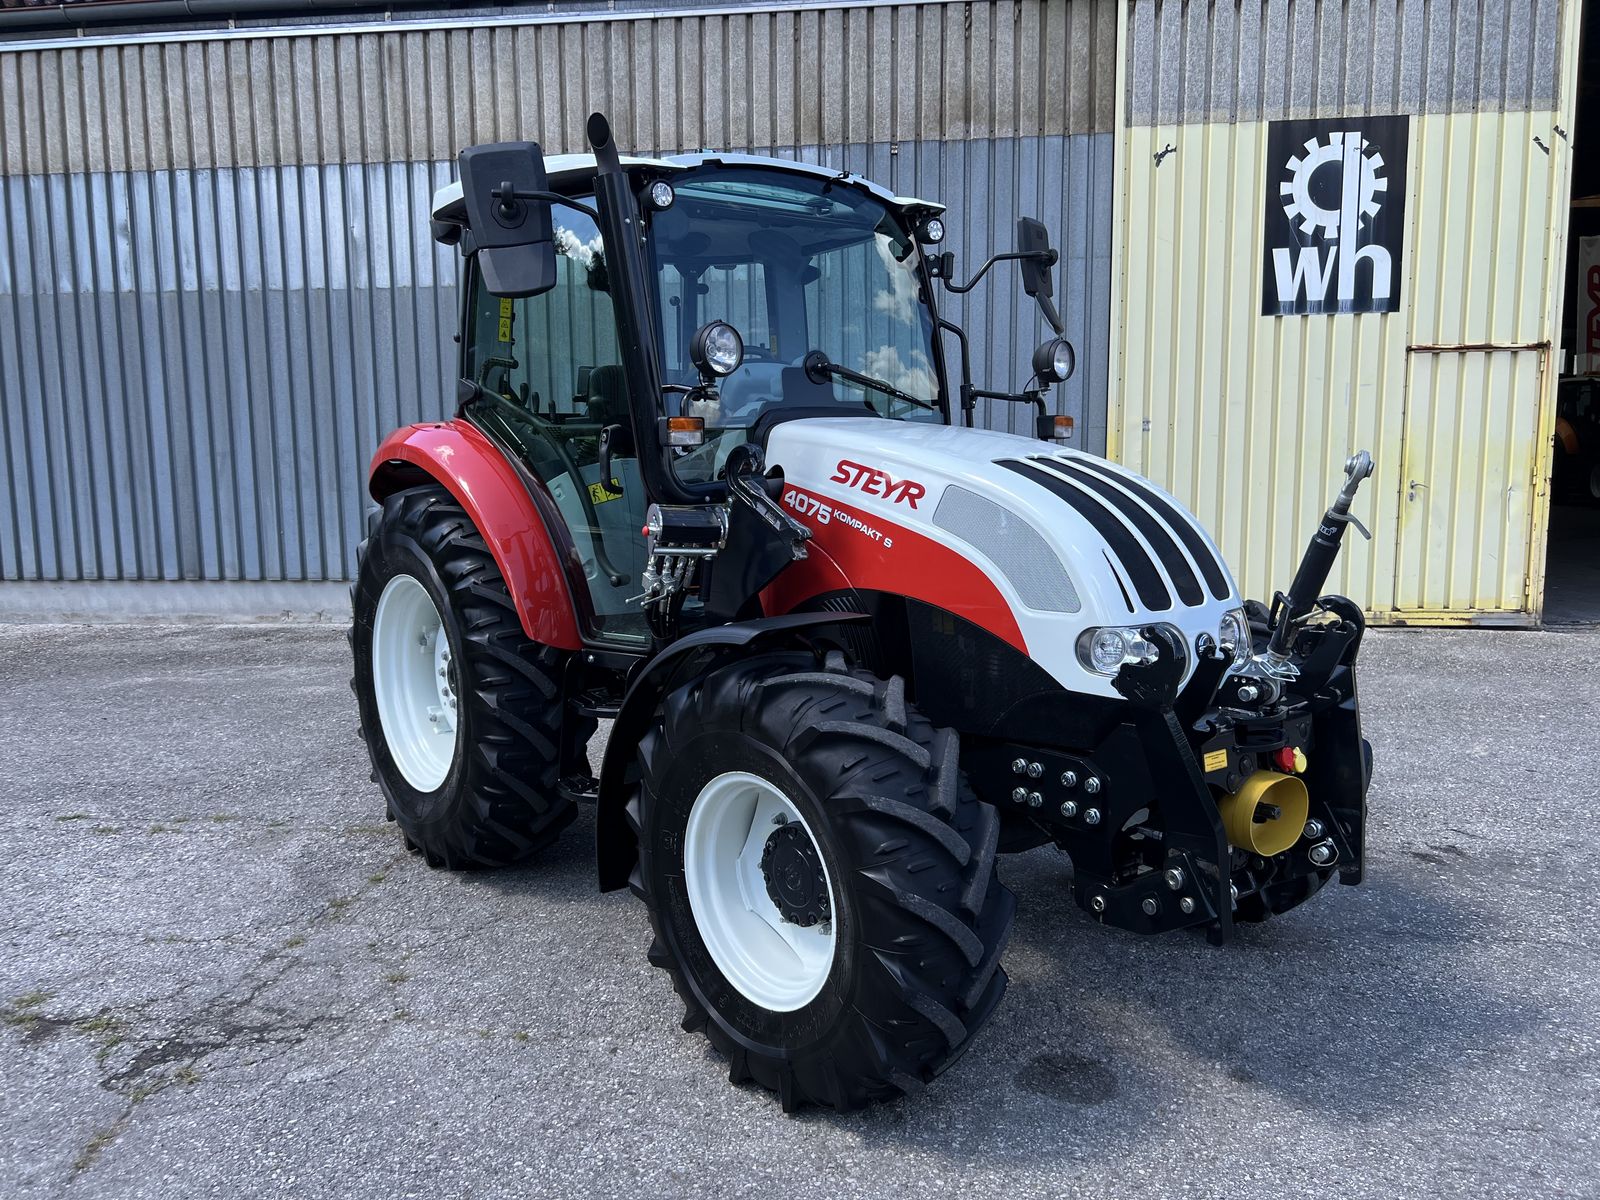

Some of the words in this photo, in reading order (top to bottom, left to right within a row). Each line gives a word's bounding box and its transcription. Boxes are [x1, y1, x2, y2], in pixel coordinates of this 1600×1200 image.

[829, 459, 926, 510] STEYR
[784, 490, 833, 525] 4075
[833, 508, 882, 541] KOMPAKT
[883, 537, 893, 548] S
